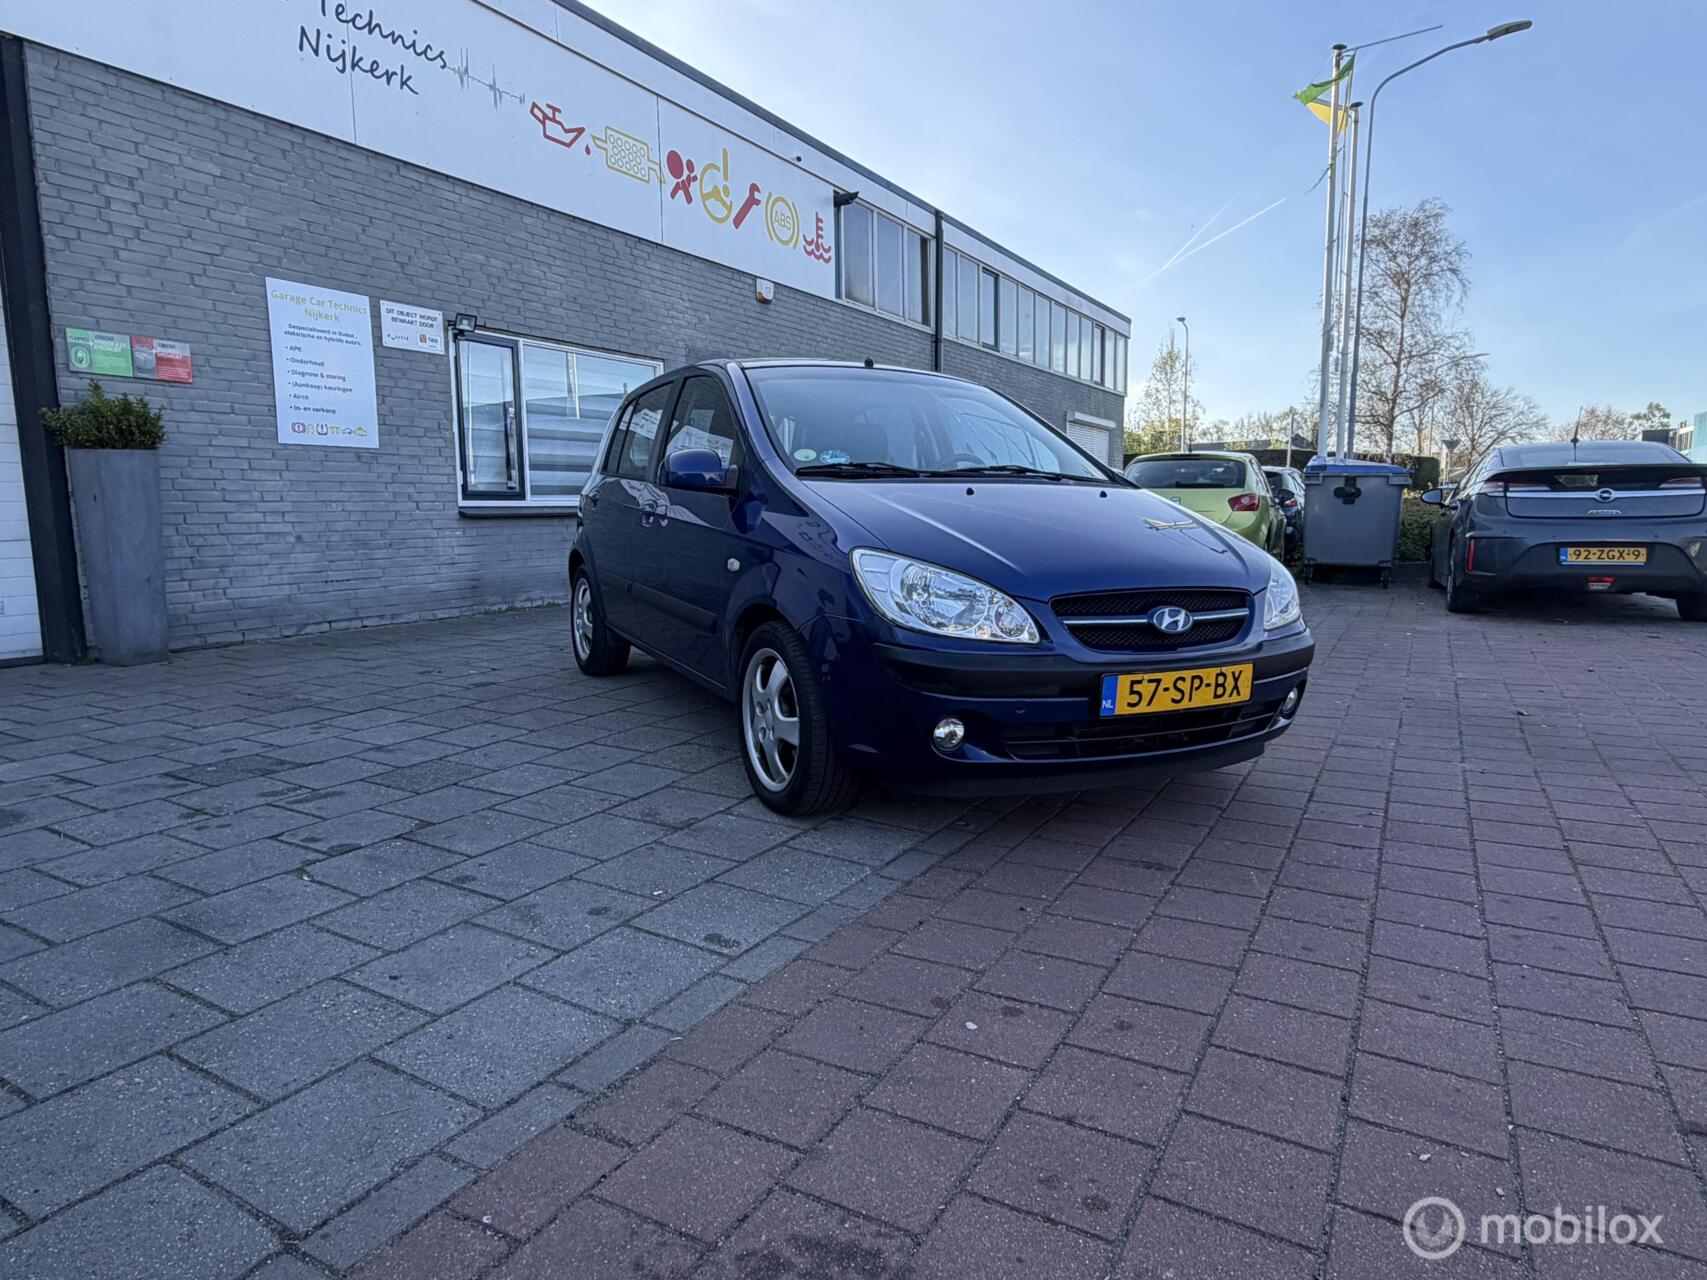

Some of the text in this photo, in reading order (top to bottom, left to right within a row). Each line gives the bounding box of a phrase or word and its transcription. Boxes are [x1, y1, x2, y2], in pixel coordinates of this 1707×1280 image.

[299, 25, 419, 95] Nijkerk
[773, 211, 792, 231] ABS
[271, 290, 367, 314] Garage Car Technics
[304, 308, 340, 321] Nijkerk
[396, 310, 418, 318] OBJECT
[290, 357, 325, 366] Onderhoud
[291, 369, 319, 377] Diagnose
[326, 373, 346, 382] storing
[312, 407, 336, 415] verkoop
[1572, 549, 1641, 560] 92-ZGX-9
[1126, 669, 1243, 708] 57-SP-BX
[1102, 699, 1114, 709] NL
